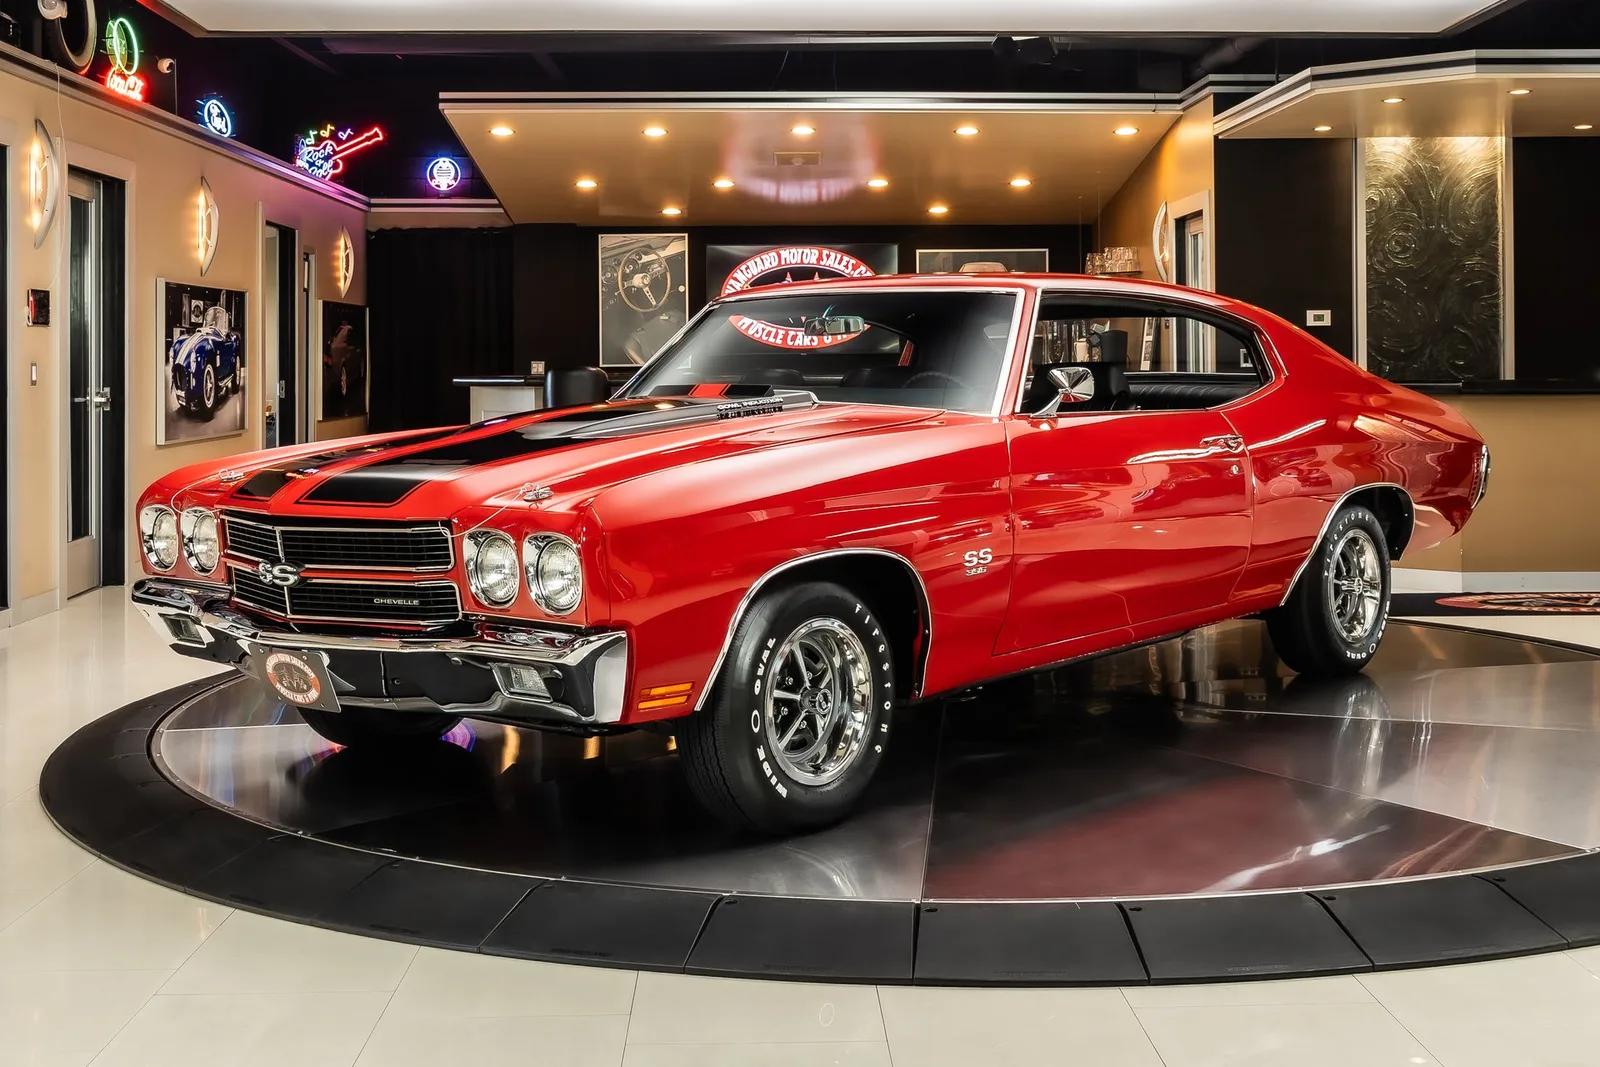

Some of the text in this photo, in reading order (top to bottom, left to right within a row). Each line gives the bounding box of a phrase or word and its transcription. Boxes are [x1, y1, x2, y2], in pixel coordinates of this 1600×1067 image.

[725, 252, 779, 294] VANGUARD
[780, 248, 818, 266] MOTOR
[738, 317, 786, 345] MUSCLE
[787, 330, 818, 346] CARS
[963, 548, 992, 567] SS
[259, 562, 297, 586] SS
[373, 598, 419, 606] CHEVELLE
[754, 638, 776, 696] OVAL
[756, 745, 788, 798] WIDE
